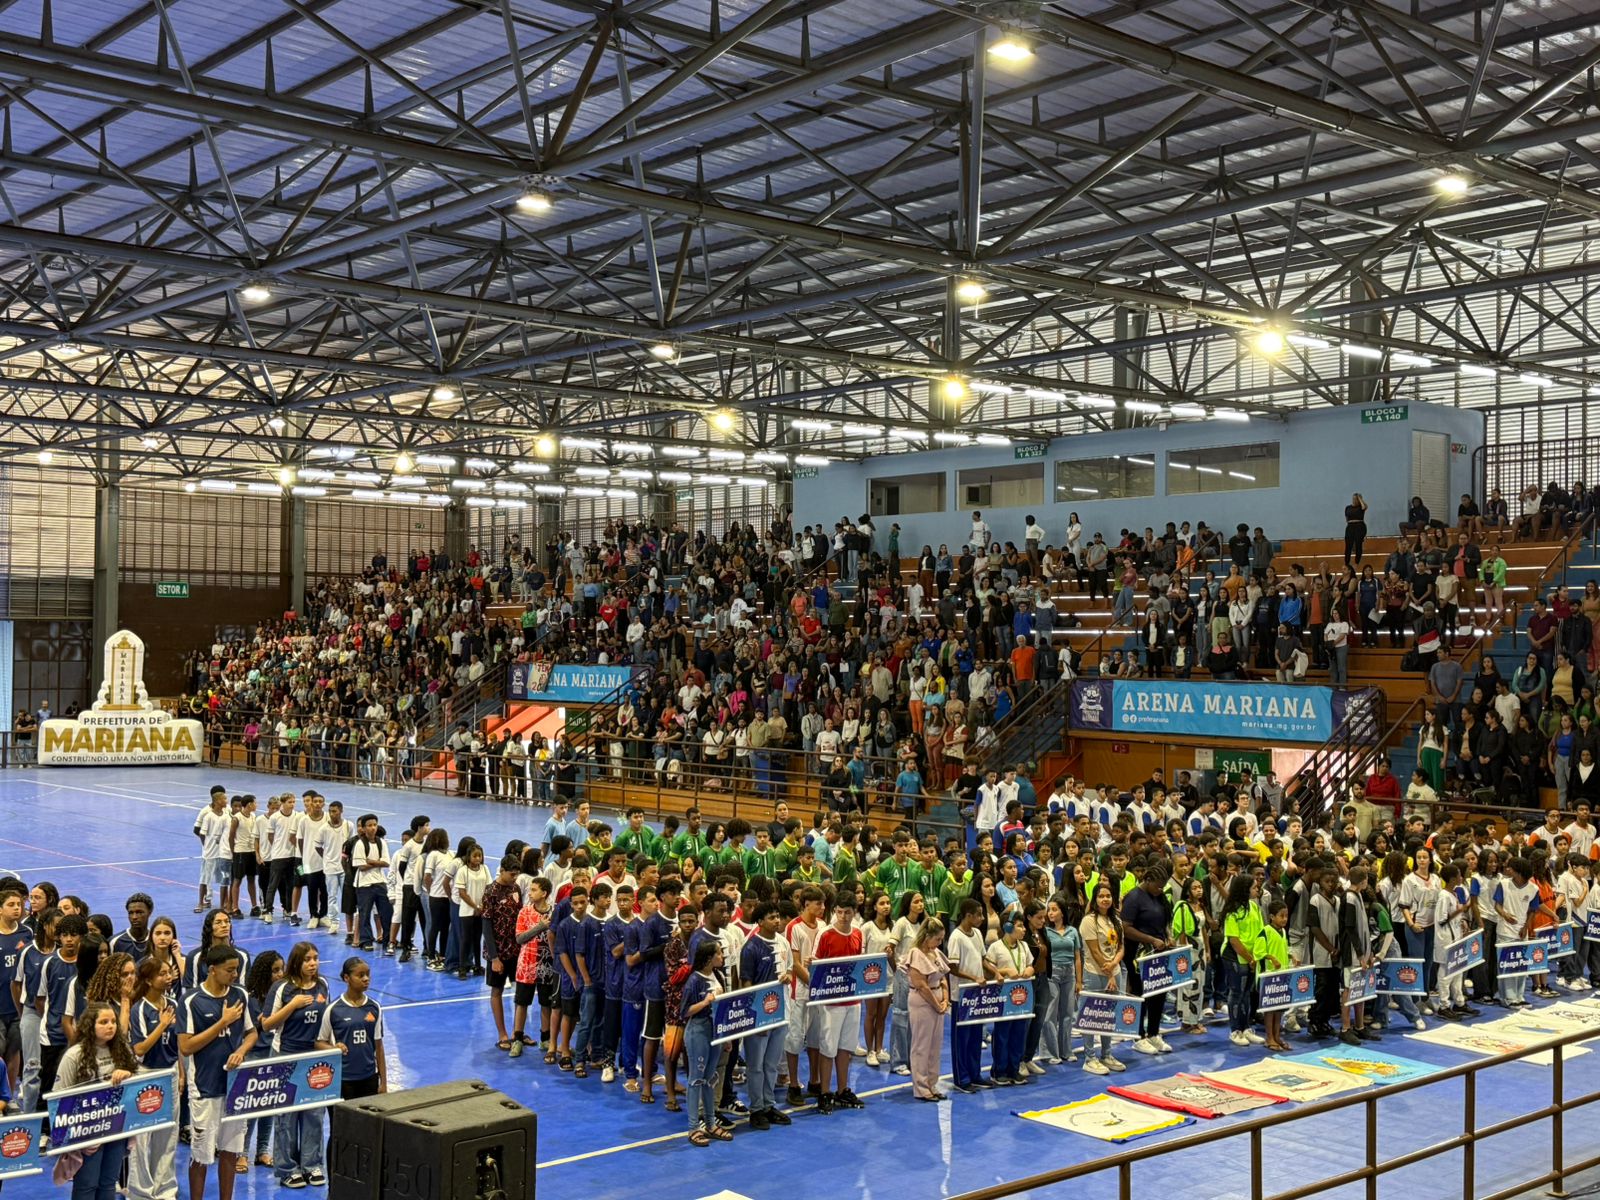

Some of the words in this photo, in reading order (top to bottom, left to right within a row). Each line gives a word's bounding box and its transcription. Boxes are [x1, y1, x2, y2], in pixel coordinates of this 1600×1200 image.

[1365, 408, 1396, 416] BLOCO
[158, 584, 180, 594] SETOR
[182, 585, 187, 595] A
[572, 673, 623, 688] MARIANA
[1122, 692, 1194, 713] ARENA
[1203, 694, 1316, 719] MARIANA
[84, 717, 146, 725] PREFEITURA
[44, 727, 196, 753] MARIANA
[1222, 758, 1260, 774] SAÍDA
[1149, 966, 1166, 977] Dona
[826, 975, 844, 984] Dom
[811, 985, 848, 996] Benevides
[1265, 984, 1288, 994] Wilson
[962, 997, 979, 1007] Prof.
[982, 995, 1007, 1004] Soares
[304, 1010, 318, 1024] 35
[728, 1009, 745, 1020] Dom
[969, 1005, 999, 1016] Ferreira
[717, 1017, 754, 1034] Benevides
[353, 1030, 367, 1044] 59
[247, 1078, 279, 1093] Dom
[82, 1099, 90, 1107] E.
[234, 1091, 287, 1111] Silvério
[55, 1104, 124, 1128] Monsenhor
[70, 1120, 111, 1139] Morais
